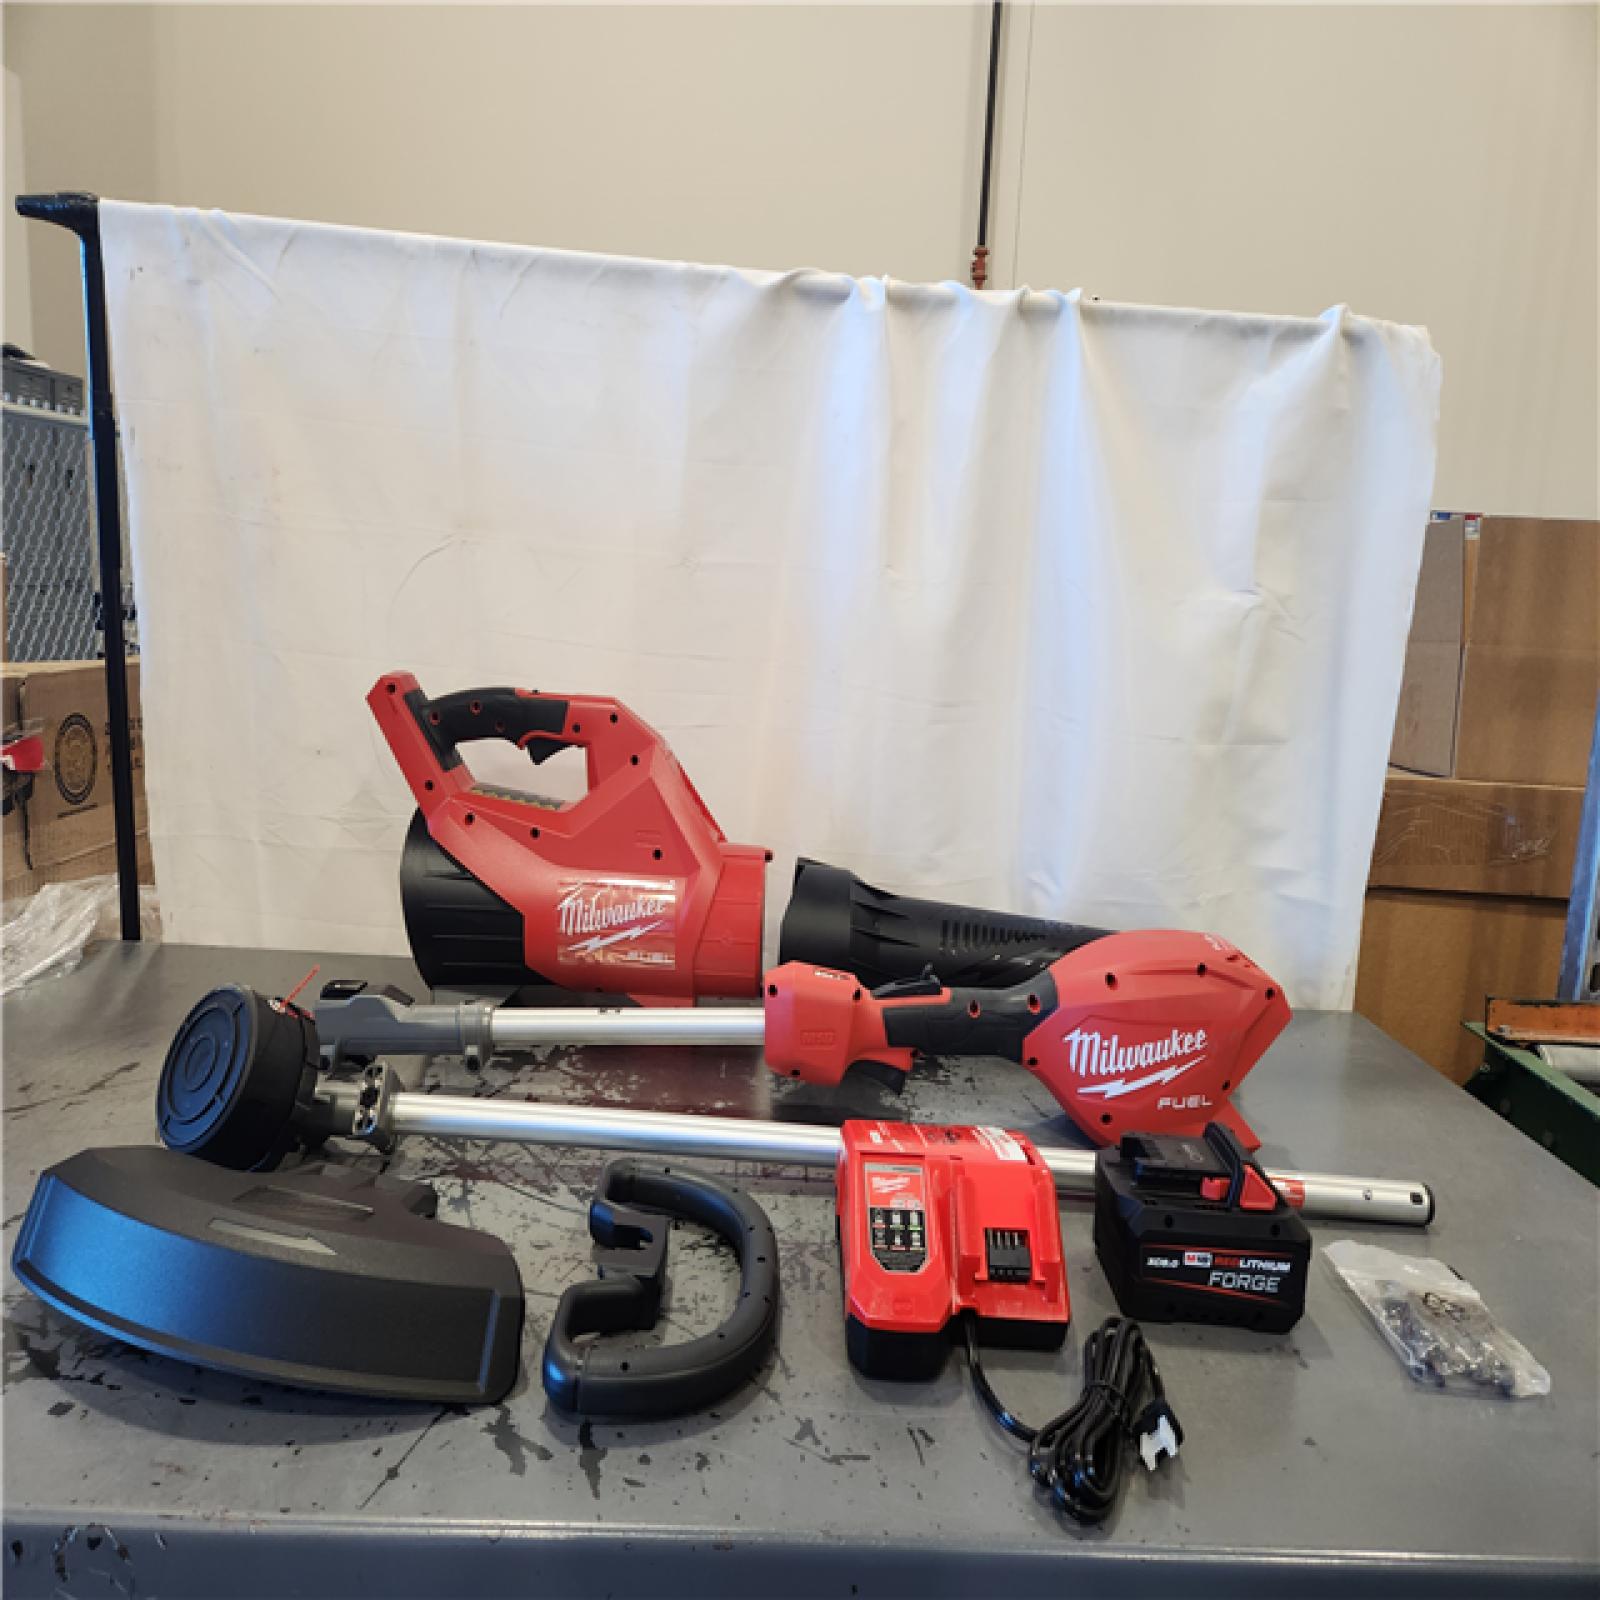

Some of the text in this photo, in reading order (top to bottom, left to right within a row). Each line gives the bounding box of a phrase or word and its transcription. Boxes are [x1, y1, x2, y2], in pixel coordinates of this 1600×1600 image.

[557, 892, 667, 936] Milwaukee
[1063, 1027, 1209, 1079] Milwaukee
[1157, 1094, 1213, 1111] FUEL
[1208, 1271, 1281, 1293] FORGE
